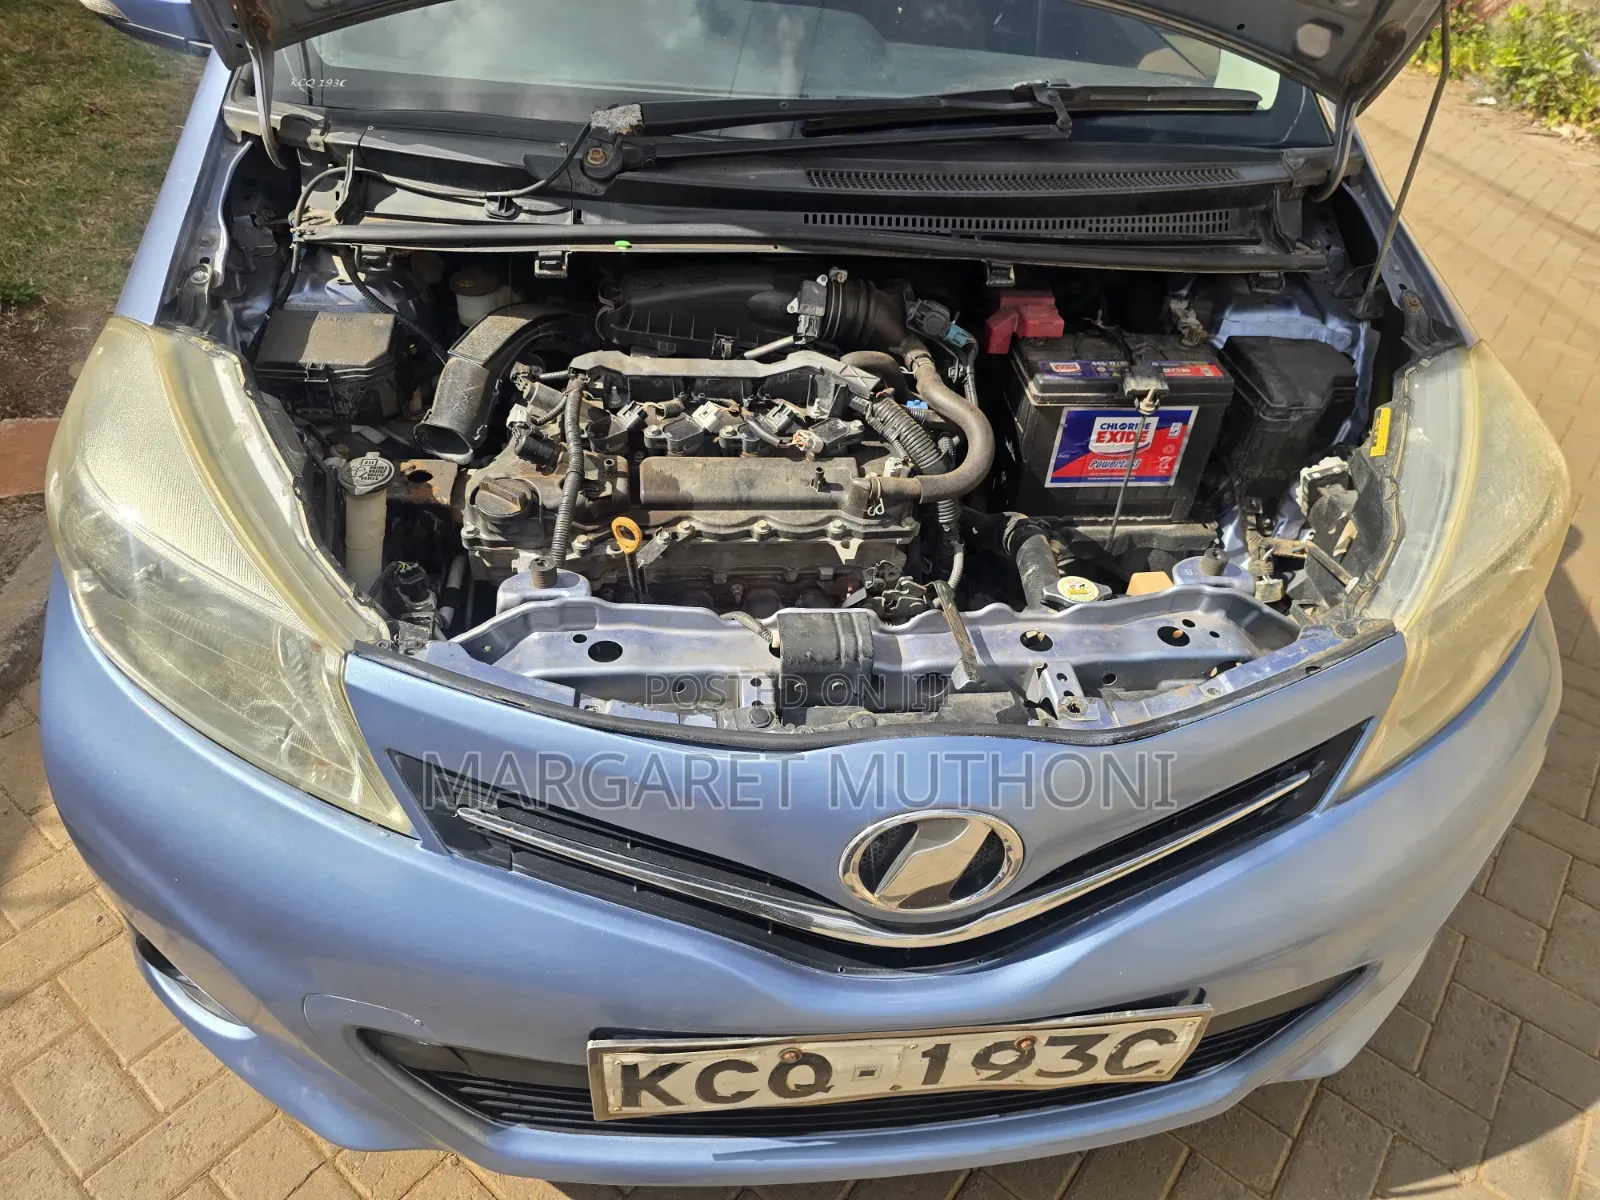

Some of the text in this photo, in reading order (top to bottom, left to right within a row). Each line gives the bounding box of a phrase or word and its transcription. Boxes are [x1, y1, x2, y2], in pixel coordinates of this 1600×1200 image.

[291, 78, 347, 88] KCQ 193C
[1096, 431, 1148, 443] EXIDE
[620, 1052, 835, 1108] KCQ
[921, 1028, 1179, 1086] 193C
